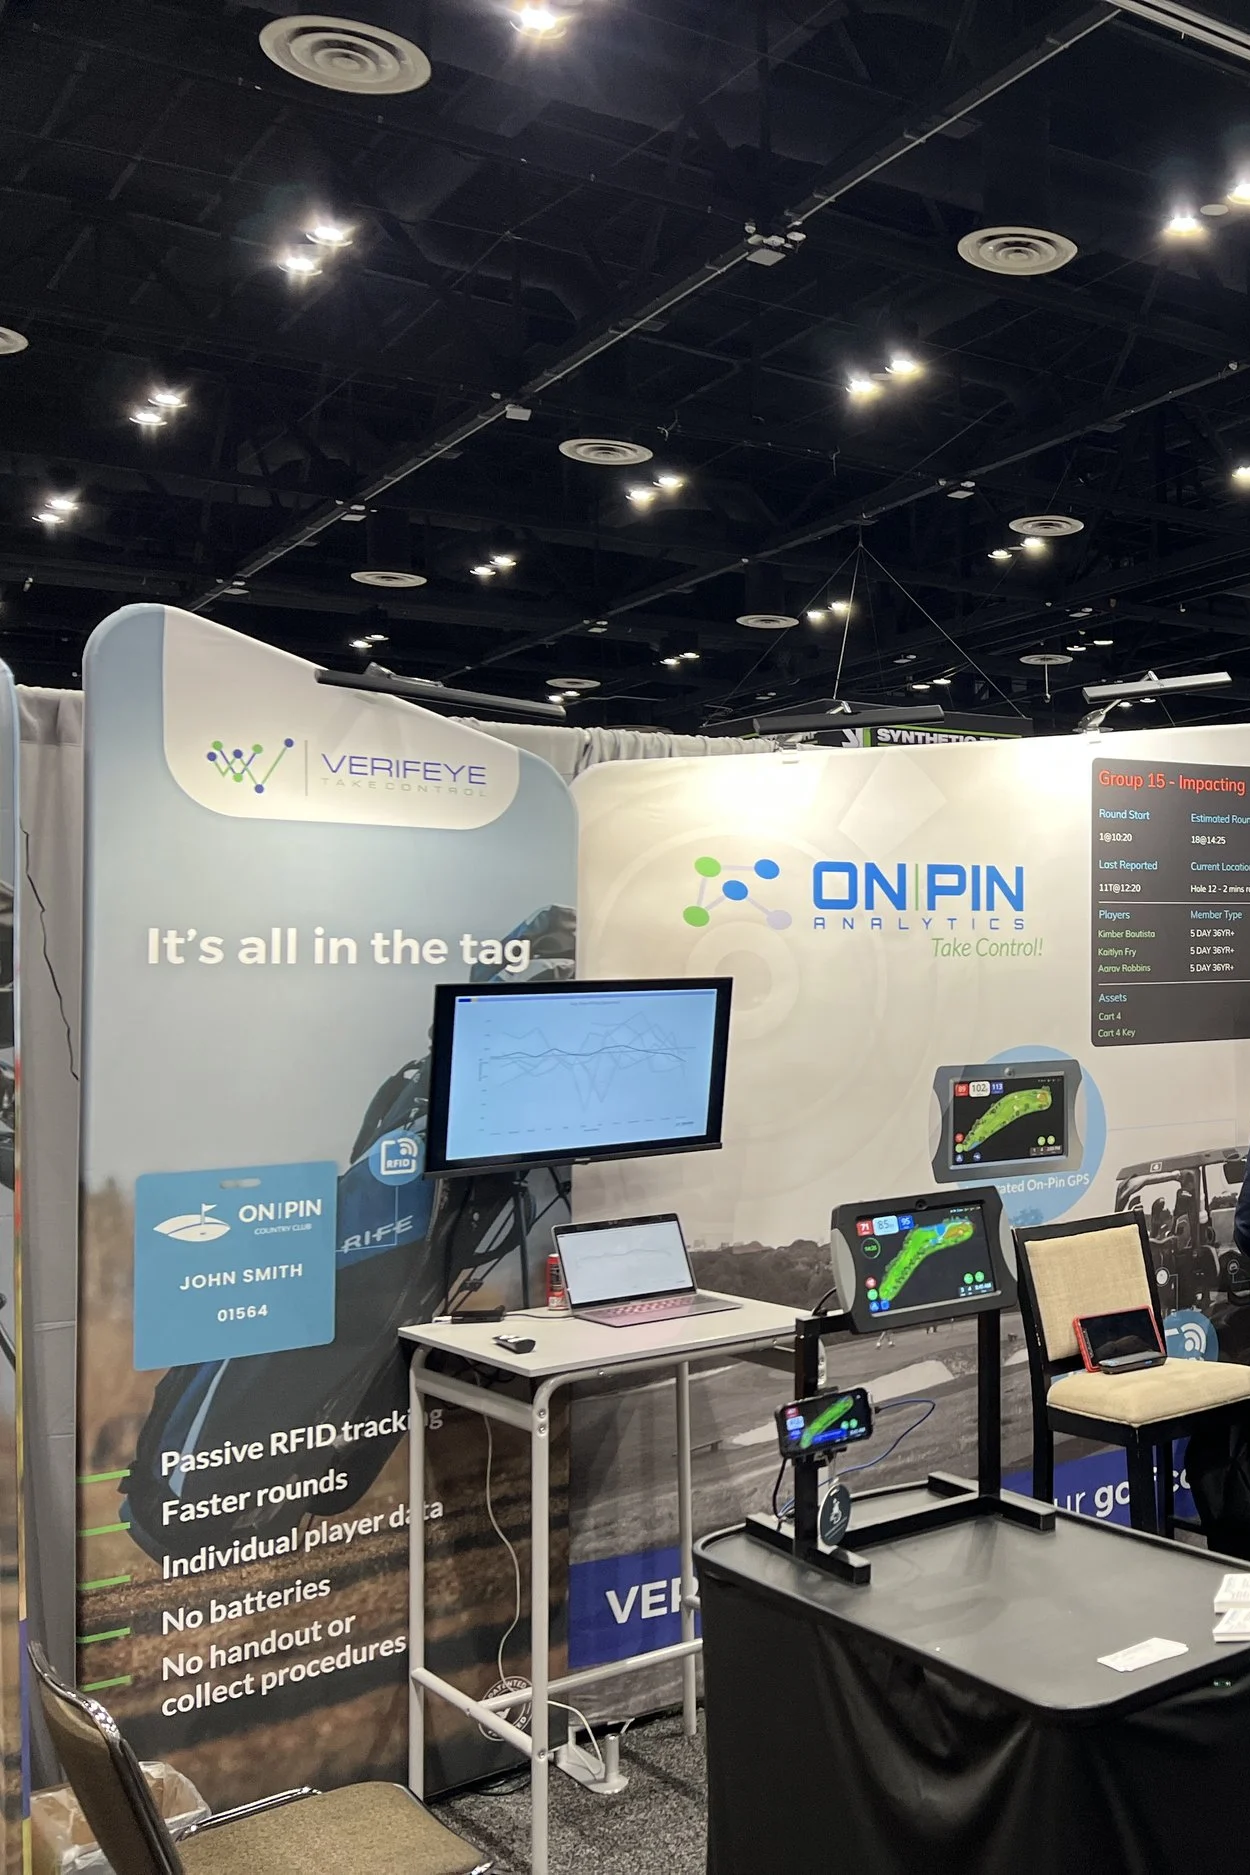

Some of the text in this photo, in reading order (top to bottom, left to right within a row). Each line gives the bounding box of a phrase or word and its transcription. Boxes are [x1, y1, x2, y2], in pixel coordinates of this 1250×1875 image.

[321, 753, 487, 785] VERIFEYE
[1099, 770, 1246, 797] Group 15 Impacting
[1099, 809, 1150, 820] Round Start
[1191, 814, 1230, 824] Estimated
[1099, 833, 1132, 842] 1@10:20
[1191, 835, 1226, 845] 18@14:25
[1099, 860, 1158, 871] Last Reported
[1191, 862, 1220, 871] Current
[1099, 884, 1141, 893] 11T@12:20
[1191, 885, 1207, 893] Hole
[1208, 885, 1217, 893] 12
[1223, 885, 1228, 893] 2
[1229, 885, 1245, 893] mins
[1099, 910, 1131, 922] Players
[1190, 910, 1243, 920] Member Type
[813, 917, 1025, 931] ANALYTICS
[1098, 930, 1156, 938] Kimber Bautista
[1190, 929, 1235, 937] 5 DAY 36YR+
[238, 928, 297, 965] all
[314, 926, 357, 965] in
[371, 929, 449, 965] the
[460, 934, 532, 973] tag
[931, 937, 1044, 957] Take Control!
[1196, 946, 1212, 954] DAY
[1213, 946, 1235, 954] 36YR+
[1098, 948, 1137, 958] Kaitlyn Fry
[1098, 964, 1151, 973] Aarav Robbins
[1190, 964, 1234, 972] 5 DAY 36YR+
[1099, 993, 1127, 1002] Assets
[1098, 1012, 1121, 1020] Cart 4
[1098, 1028, 1136, 1037] Cart 4 Key
[971, 1084, 986, 1092] 102
[386, 1157, 411, 1169] RFID
[1026, 1175, 1066, 1192] On-Pin
[1067, 1173, 1090, 1187] GPS
[860, 1223, 870, 1231] 71
[877, 1219, 889, 1230] 85
[900, 1217, 911, 1226] 95
[254, 1223, 312, 1236] COUNTRY CLUB
[180, 1263, 304, 1291] JOHN SMITH
[217, 1304, 269, 1322] 01564
[160, 1424, 337, 1477] Passive RFID
[161, 1468, 349, 1526] Faster rounds
[161, 1527, 297, 1580] Individual
[304, 1513, 384, 1553] player
[161, 1576, 331, 1636] No batteries
[161, 1611, 357, 1682] No handout or
[160, 1634, 408, 1718] collect procedures
